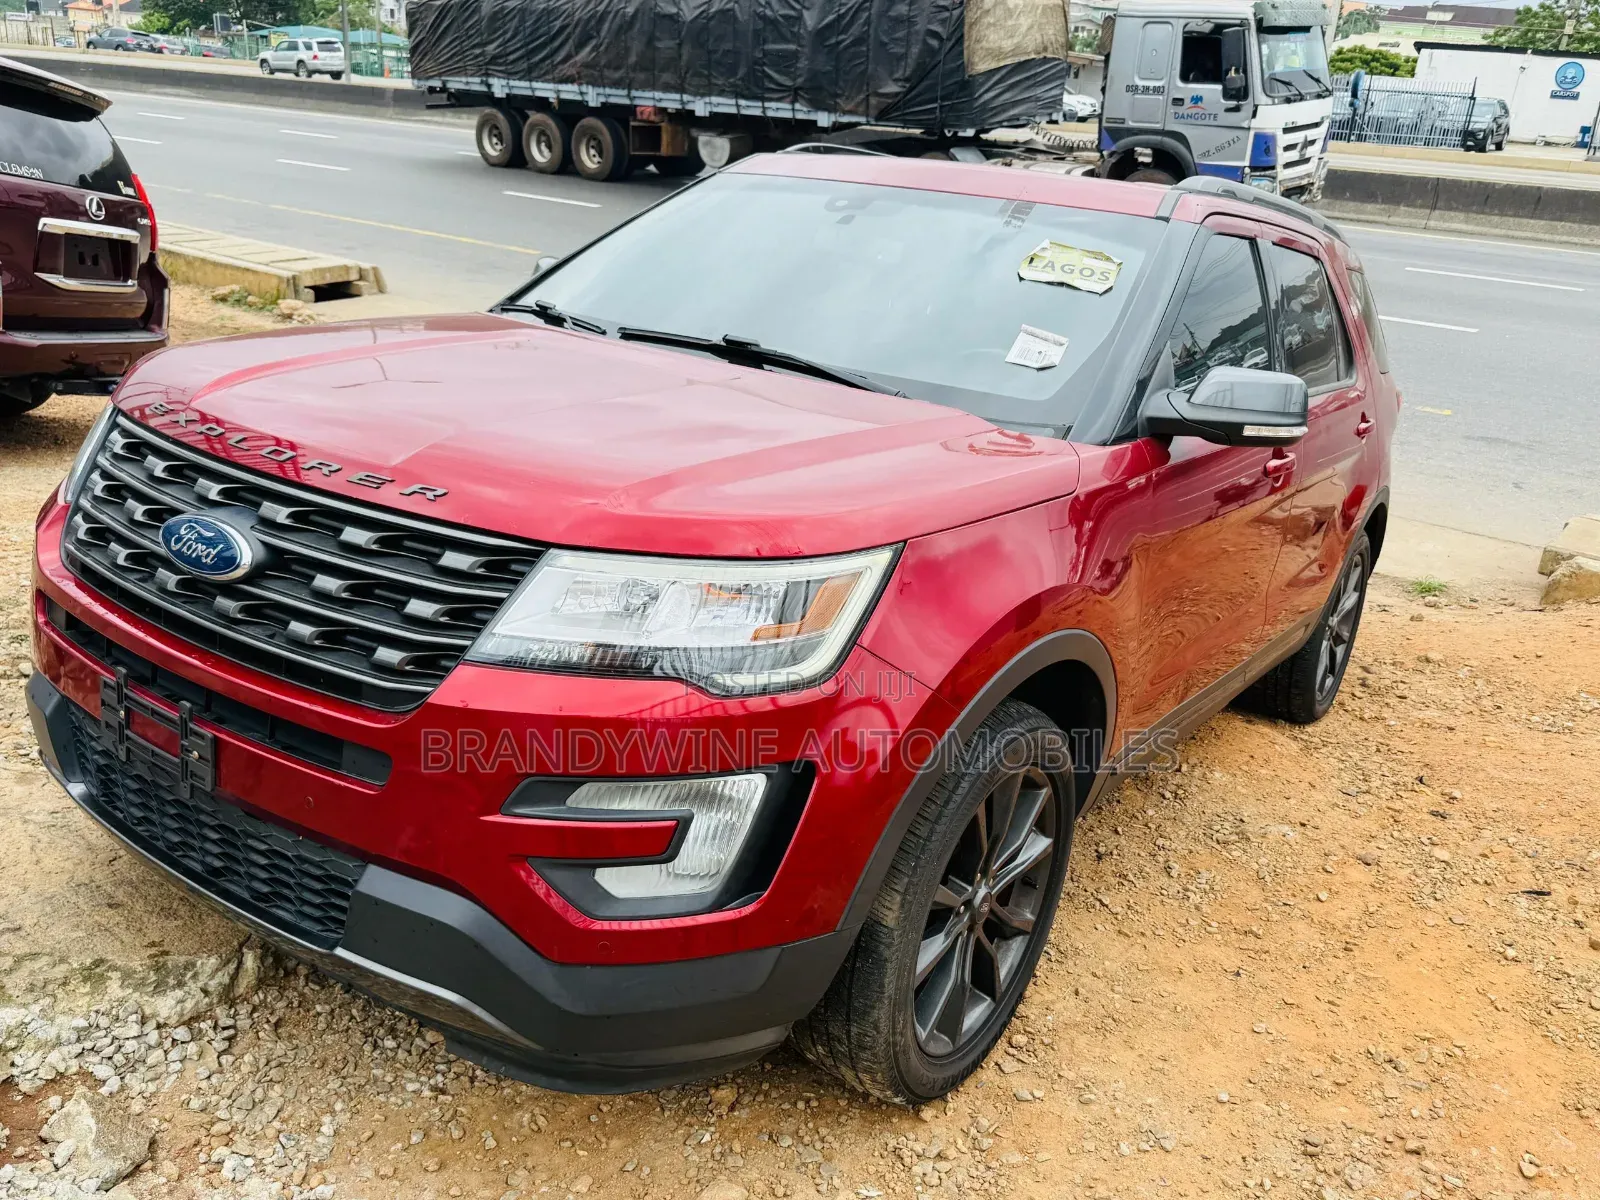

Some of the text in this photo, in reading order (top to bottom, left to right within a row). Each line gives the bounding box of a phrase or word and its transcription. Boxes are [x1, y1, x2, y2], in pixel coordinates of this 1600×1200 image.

[1173, 111, 1219, 121] DANGOTE
[1027, 256, 1111, 282] LAGOS
[149, 401, 449, 501] EXPLORER
[170, 522, 224, 565] Ford
